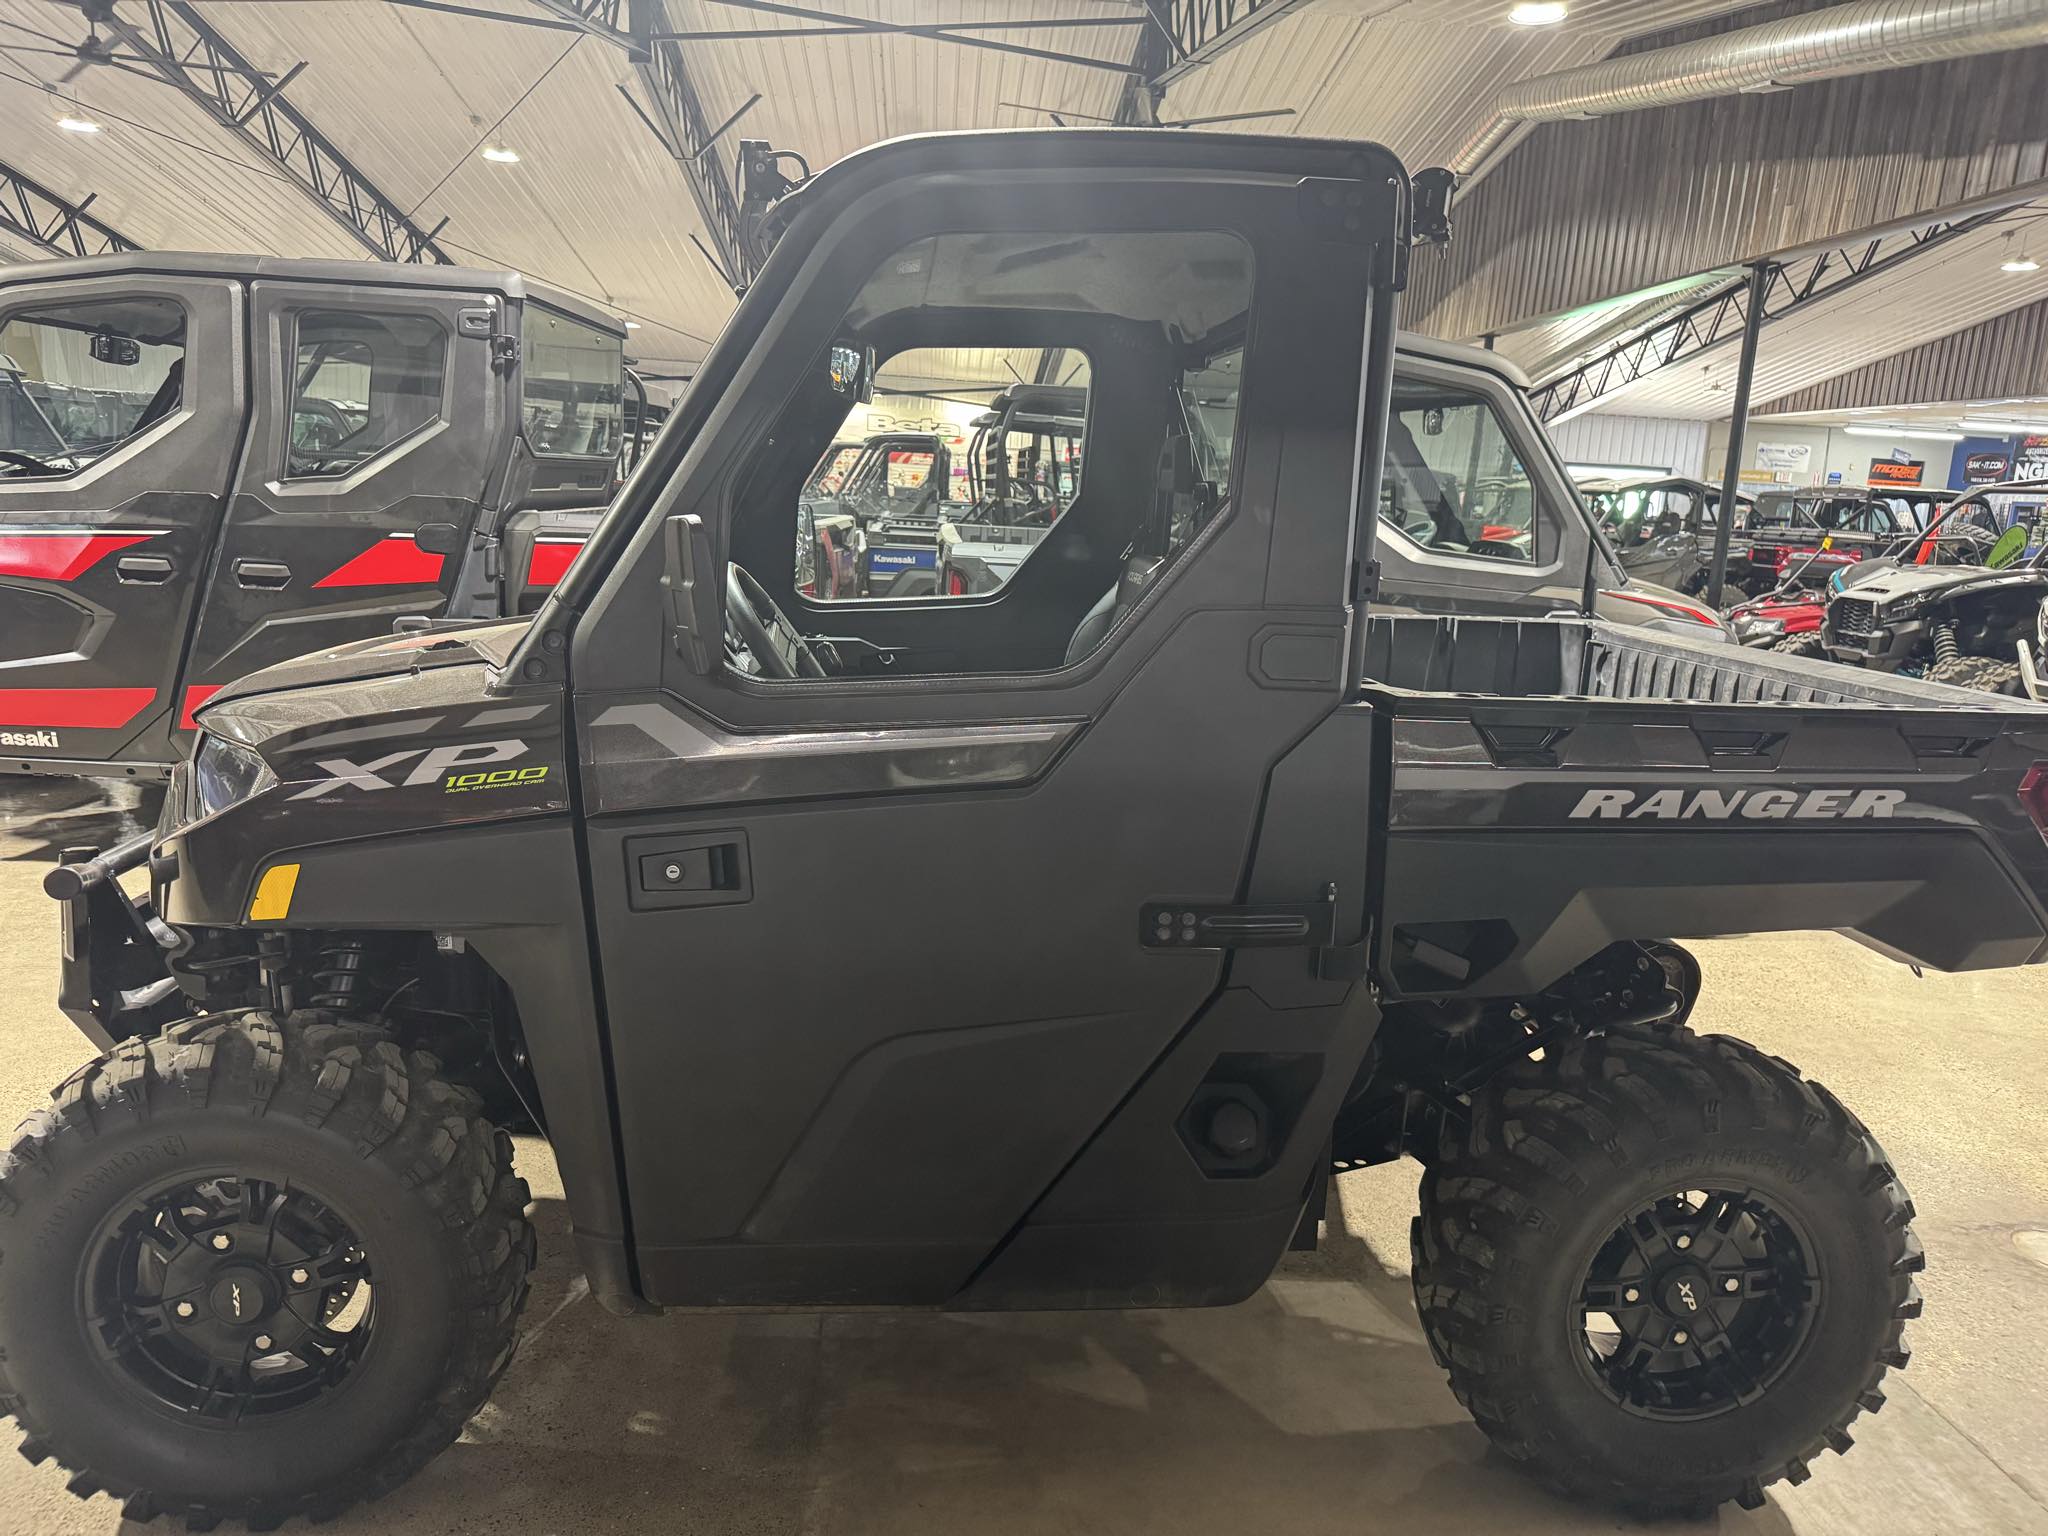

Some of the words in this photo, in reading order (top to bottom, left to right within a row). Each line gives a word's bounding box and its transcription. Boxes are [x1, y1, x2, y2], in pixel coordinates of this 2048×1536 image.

[867, 414, 961, 437] Beta
[1871, 463, 1921, 475] MOOSE
[873, 554, 916, 565] Kawasaki
[0, 731, 59, 748] asaki
[284, 739, 530, 801] XP
[446, 766, 549, 787] 1000
[472, 781, 523, 791] OVERHEAD
[1568, 789, 1907, 819] RANGER
[232, 1283, 240, 1317] XP
[1677, 1282, 1697, 1311] XP
